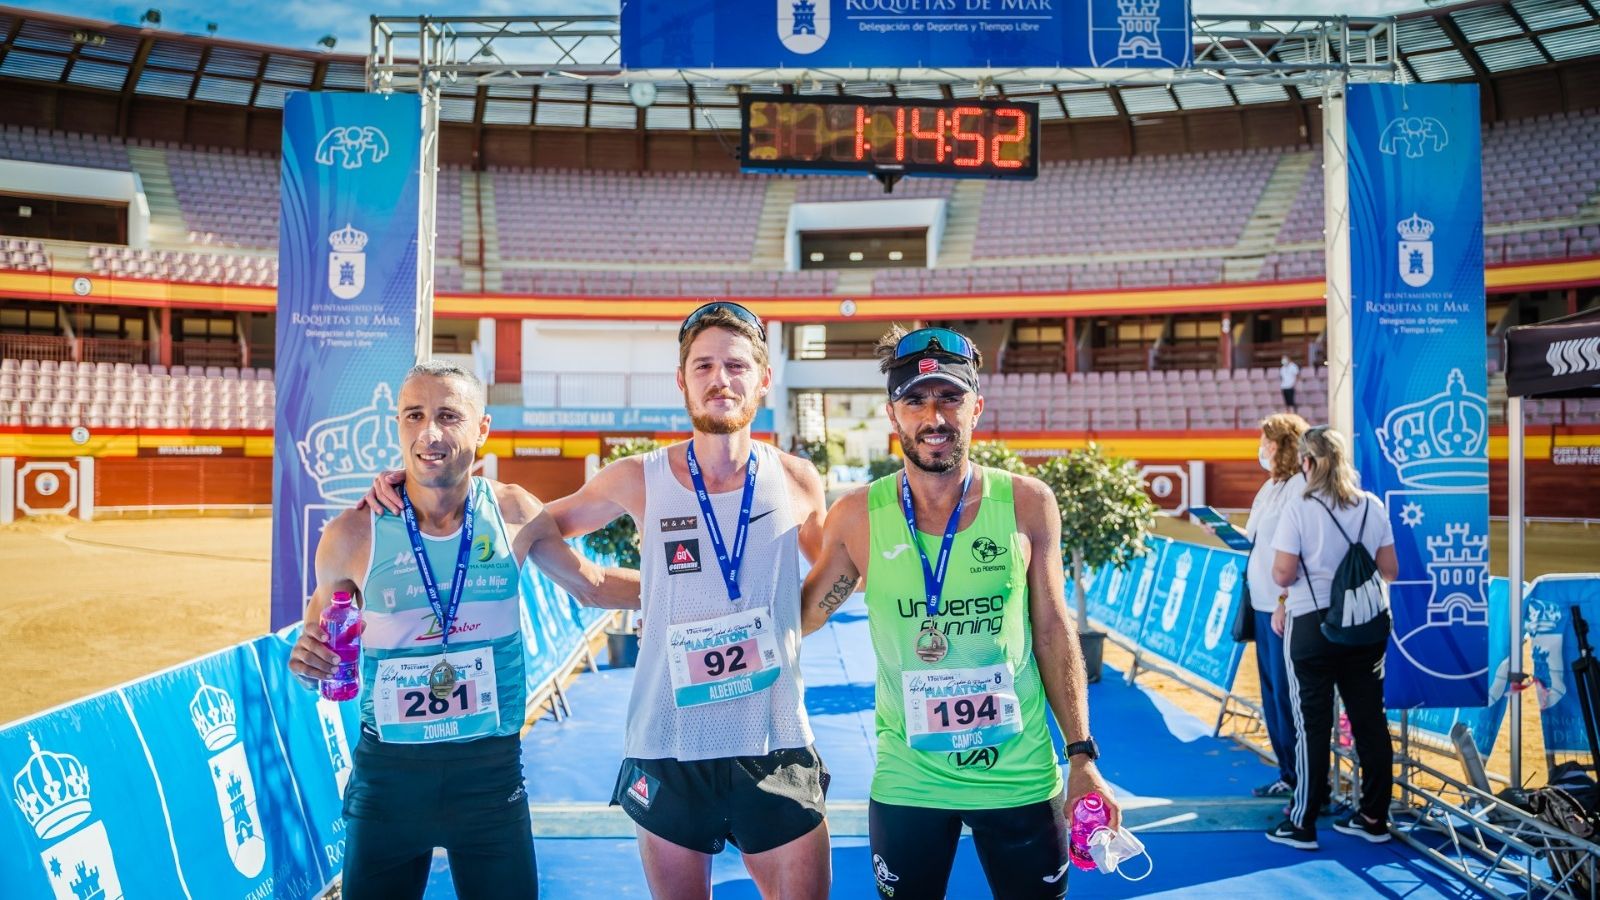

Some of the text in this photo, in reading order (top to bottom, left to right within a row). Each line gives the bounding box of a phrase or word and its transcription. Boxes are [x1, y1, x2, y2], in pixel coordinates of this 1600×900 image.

[966, 0, 991, 10] DE
[1001, 0, 1053, 10] MAR
[859, 22, 1040, 33] Delegación de Deportes y Tiempo Libre
[856, 105, 1026, 168] 1:14:52
[1366, 301, 1469, 314] ROQUETAS DE MAR
[292, 312, 401, 326] ROQUETAS DE MAR
[1400, 326, 1425, 334] Tiempo
[326, 339, 353, 347] Tiempo
[158, 446, 222, 455] MULILLEROS
[476, 575, 487, 587] de
[704, 645, 747, 677] 92
[404, 684, 468, 718] 281
[934, 695, 998, 727] 194
[423, 721, 459, 740] ZOUHAIR
[952, 731, 983, 749] CAMPOS
